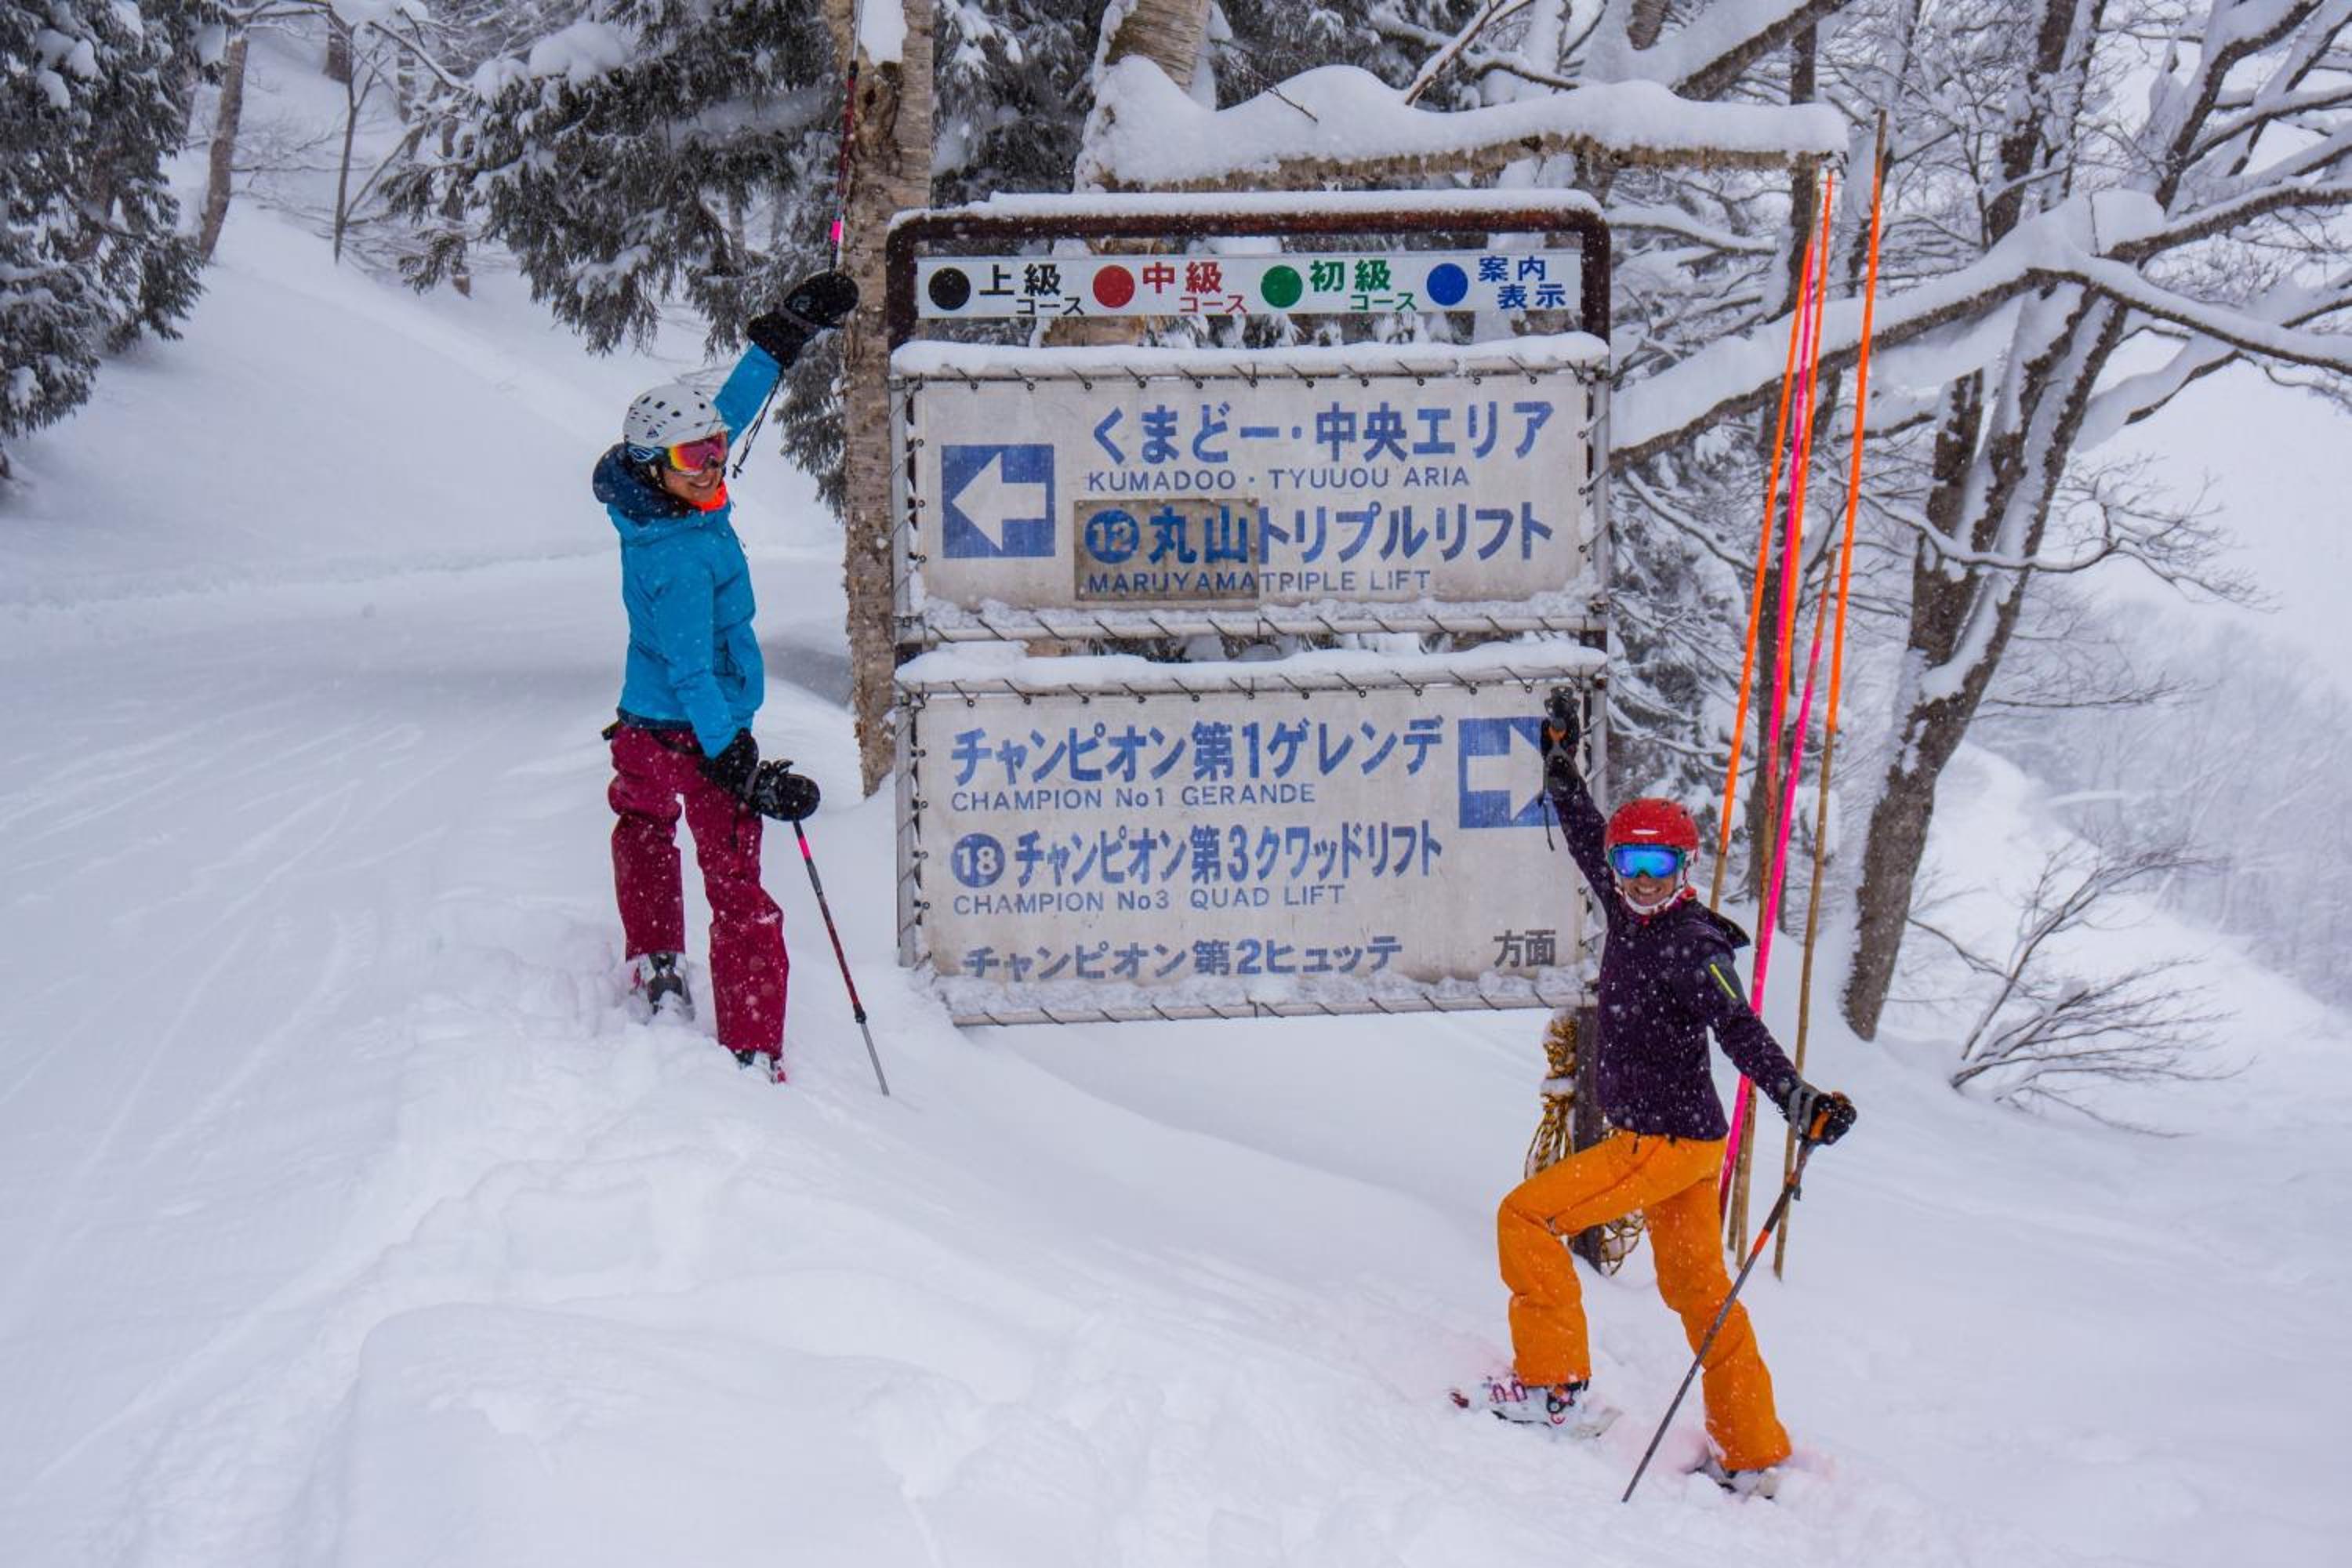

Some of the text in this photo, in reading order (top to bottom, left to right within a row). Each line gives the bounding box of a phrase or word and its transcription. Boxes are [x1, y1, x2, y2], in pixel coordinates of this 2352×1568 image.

[979, 263, 1061, 296] 上級
[1142, 261, 1222, 294] 中級
[1309, 260, 1392, 292] 初級
[1479, 256, 1546, 281] 案内
[1016, 296, 1084, 315] コース
[1179, 295, 1247, 314] コース
[1350, 292, 1417, 311] コース
[1497, 283, 1566, 310] 表示
[1088, 470, 1236, 492] KUMADOO
[1269, 468, 1389, 490] TYUUOU
[1403, 466, 1470, 488] ARIA
[1088, 569, 1432, 593] MARUYAMA TRIPLE LIFT
[951, 714, 1444, 786] チャンピオン第1ゲレンデ
[951, 789, 1102, 811] CHAMPION
[1181, 783, 1316, 806] GERANDE
[953, 892, 1104, 915] CHAMPION
[1190, 887, 1270, 910] QUAD
[1284, 884, 1345, 906] LIFT
[1494, 929, 1557, 969] 方面
